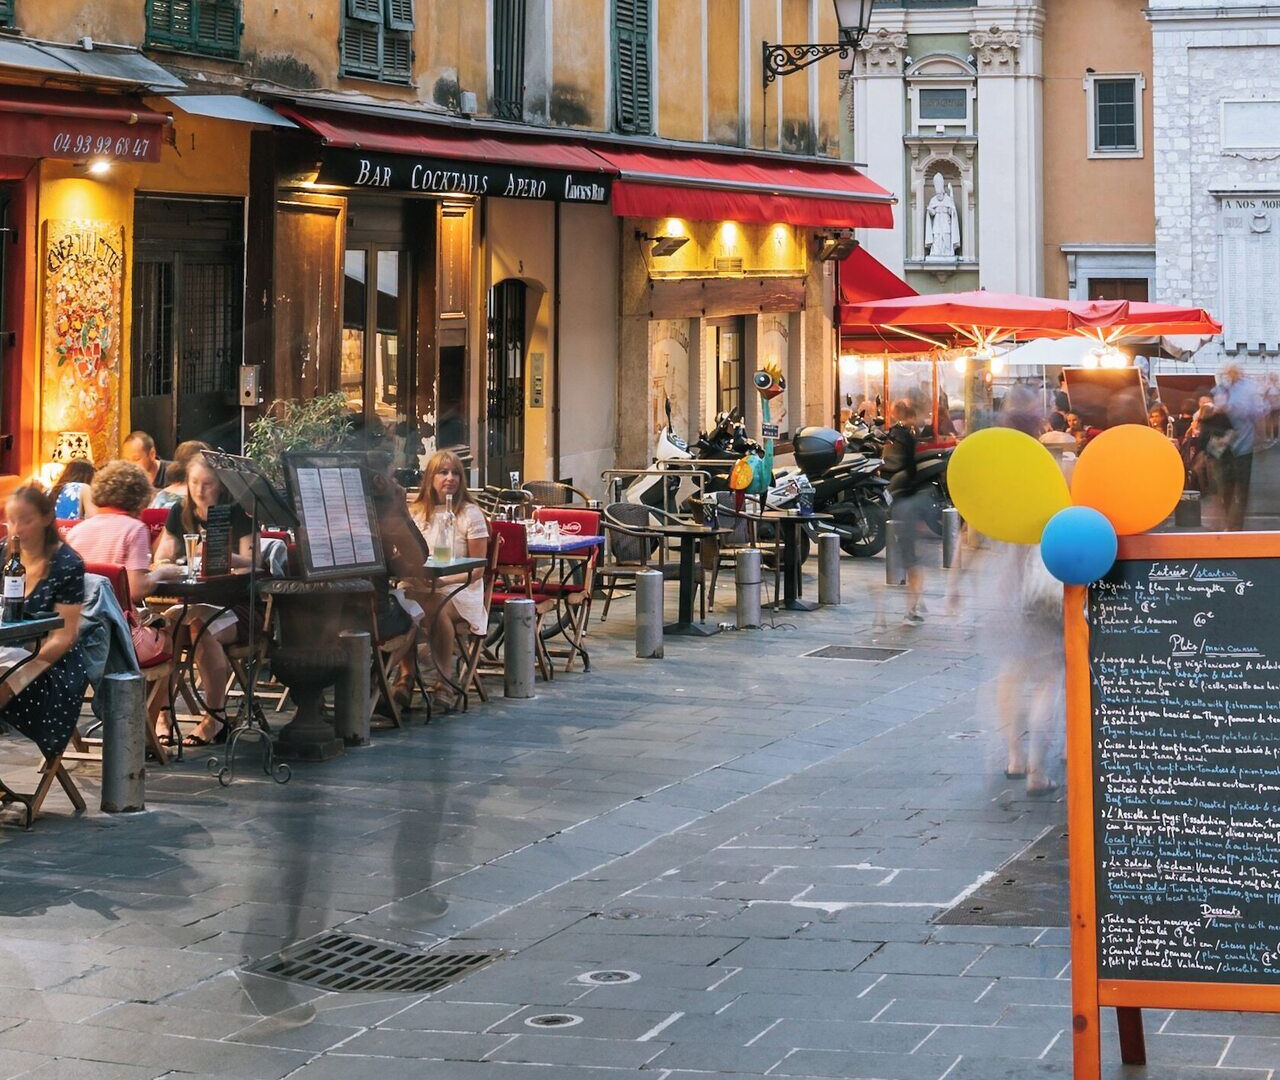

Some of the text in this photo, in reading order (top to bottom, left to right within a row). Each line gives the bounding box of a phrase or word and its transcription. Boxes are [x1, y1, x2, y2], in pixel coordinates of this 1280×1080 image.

[53, 133, 149, 156] 04 93 92 68 47
[354, 159, 392, 187] BAR
[412, 164, 489, 194] COCKTAILS
[504, 172, 547, 198] APERO
[591, 184, 604, 200] BAR
[1236, 200, 1255, 208] NOS
[1170, 634, 1198, 651] Plats
